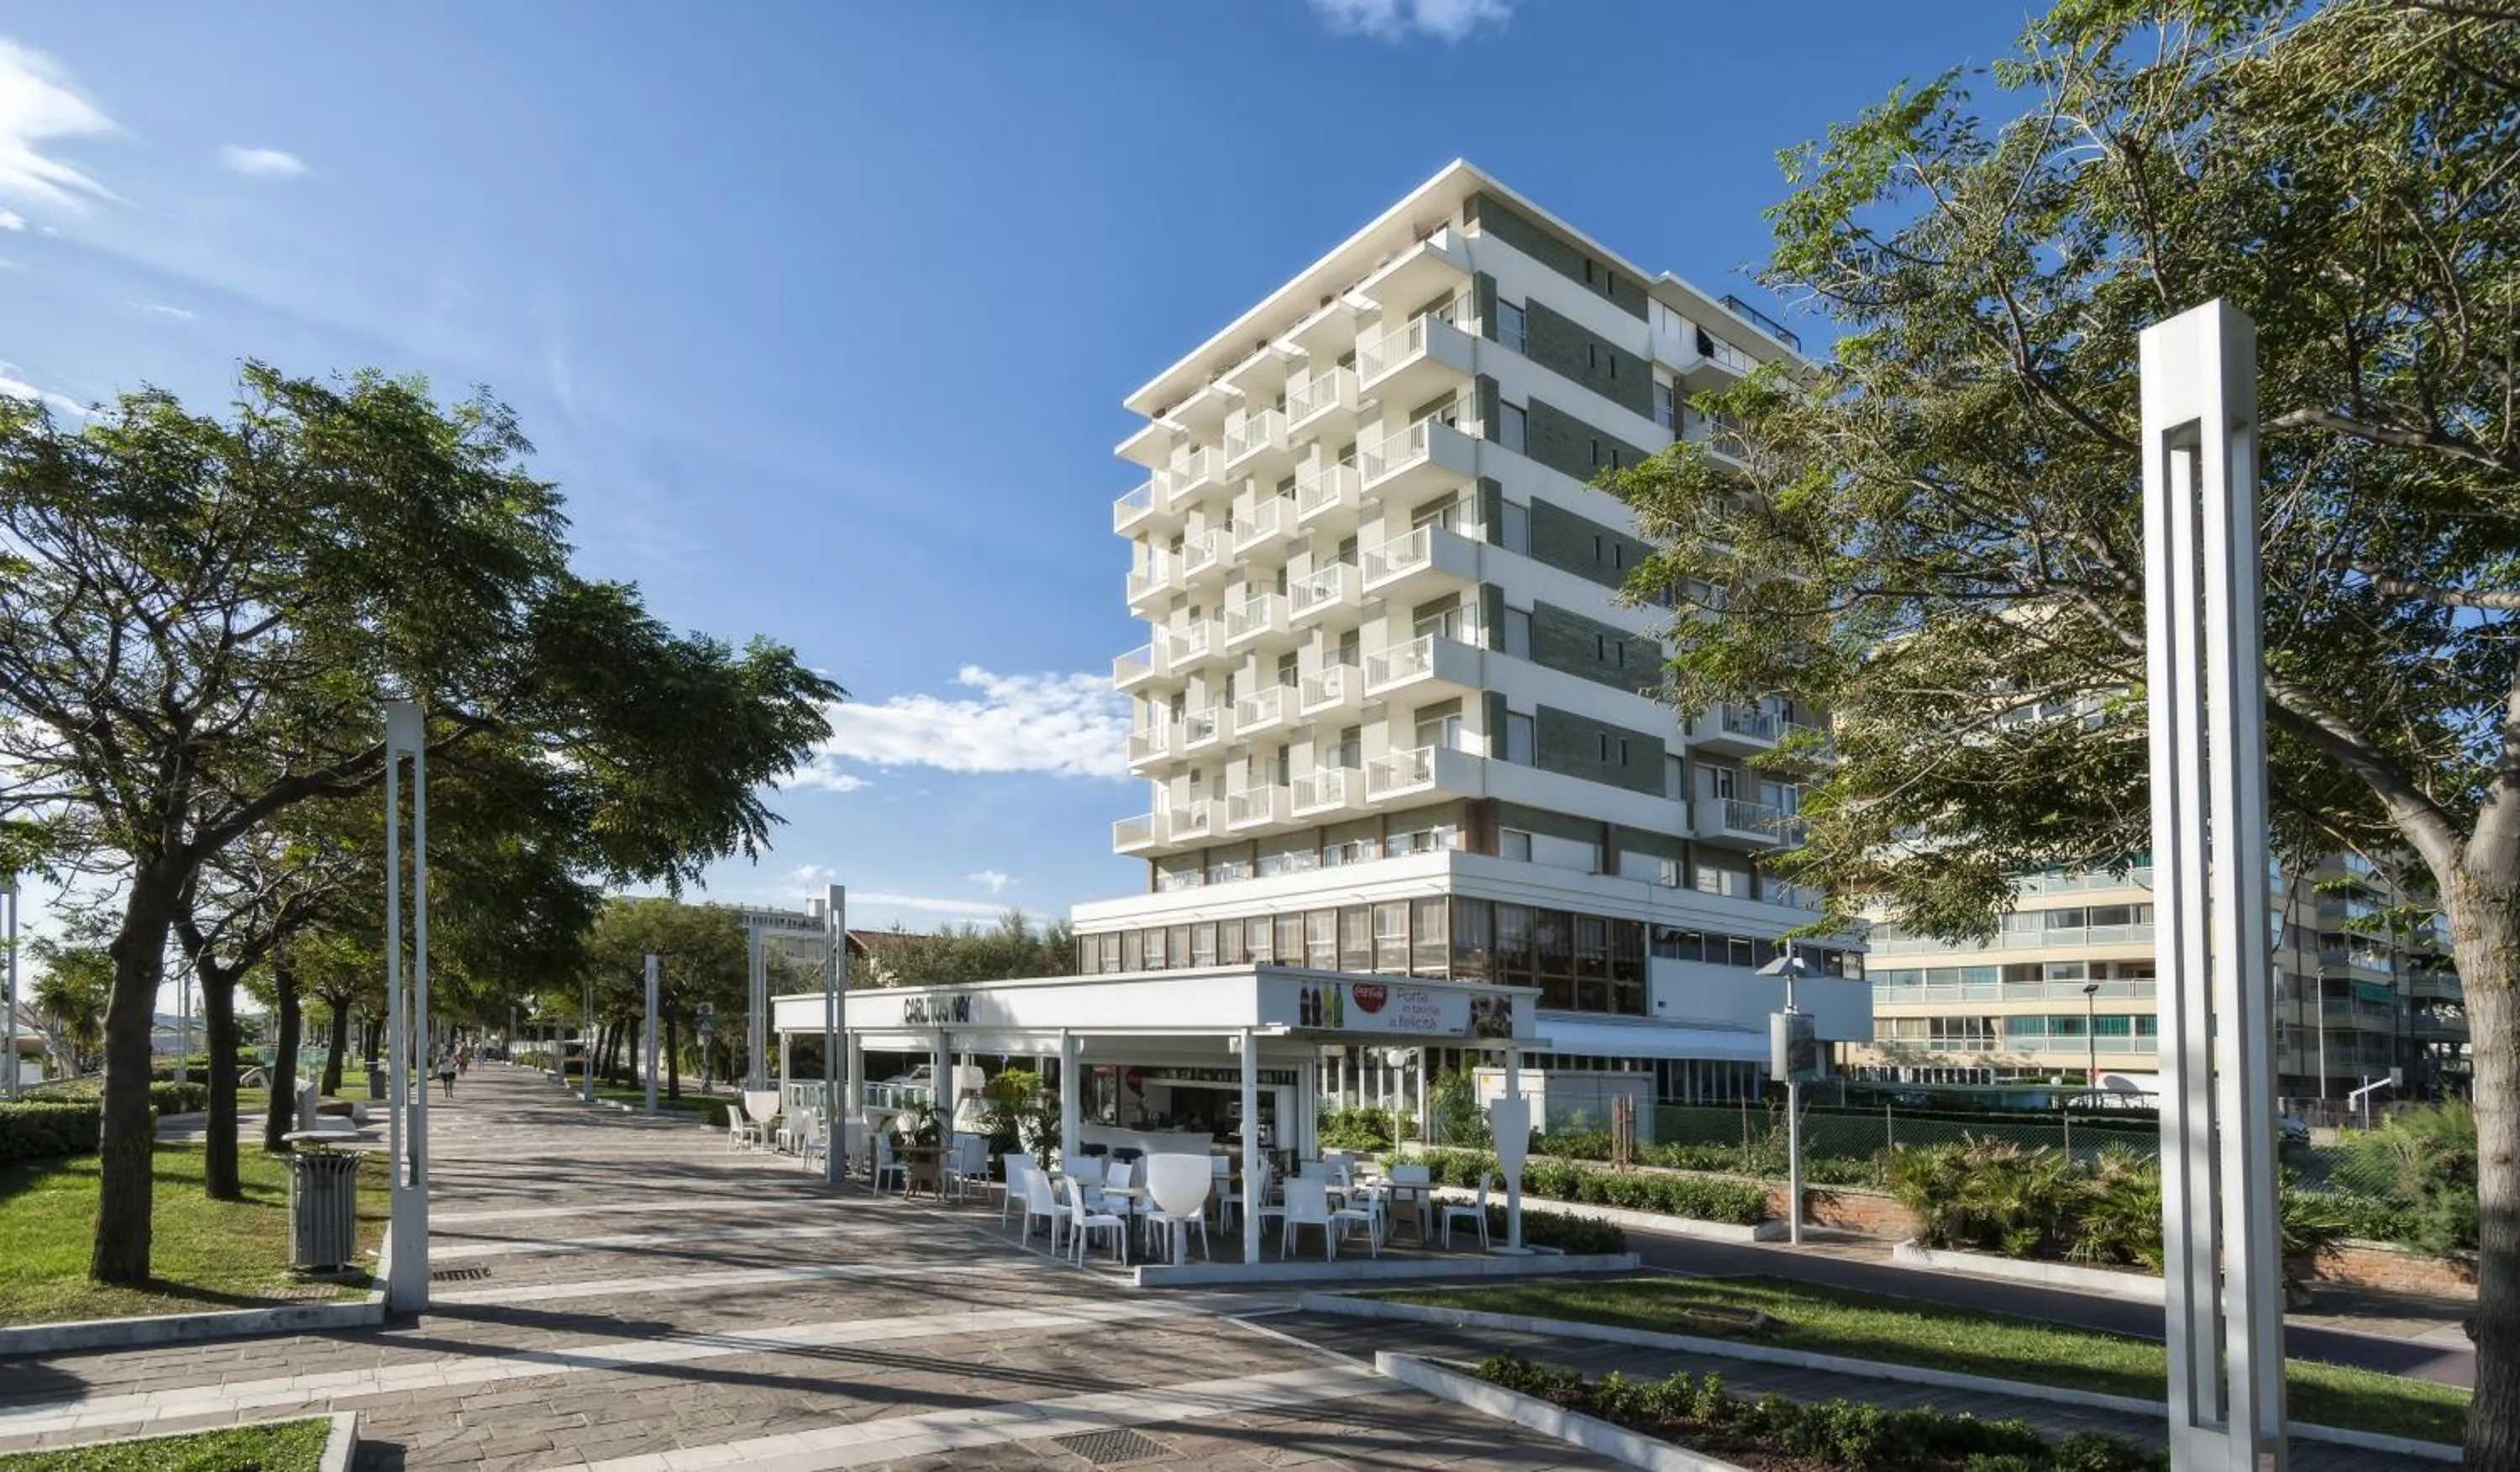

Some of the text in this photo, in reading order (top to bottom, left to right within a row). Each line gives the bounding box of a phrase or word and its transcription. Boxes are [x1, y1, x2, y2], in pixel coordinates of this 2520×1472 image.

[1397, 989, 1428, 1003] Porta
[951, 995, 970, 1023] WAY
[1399, 1015, 1437, 1029] felicità
